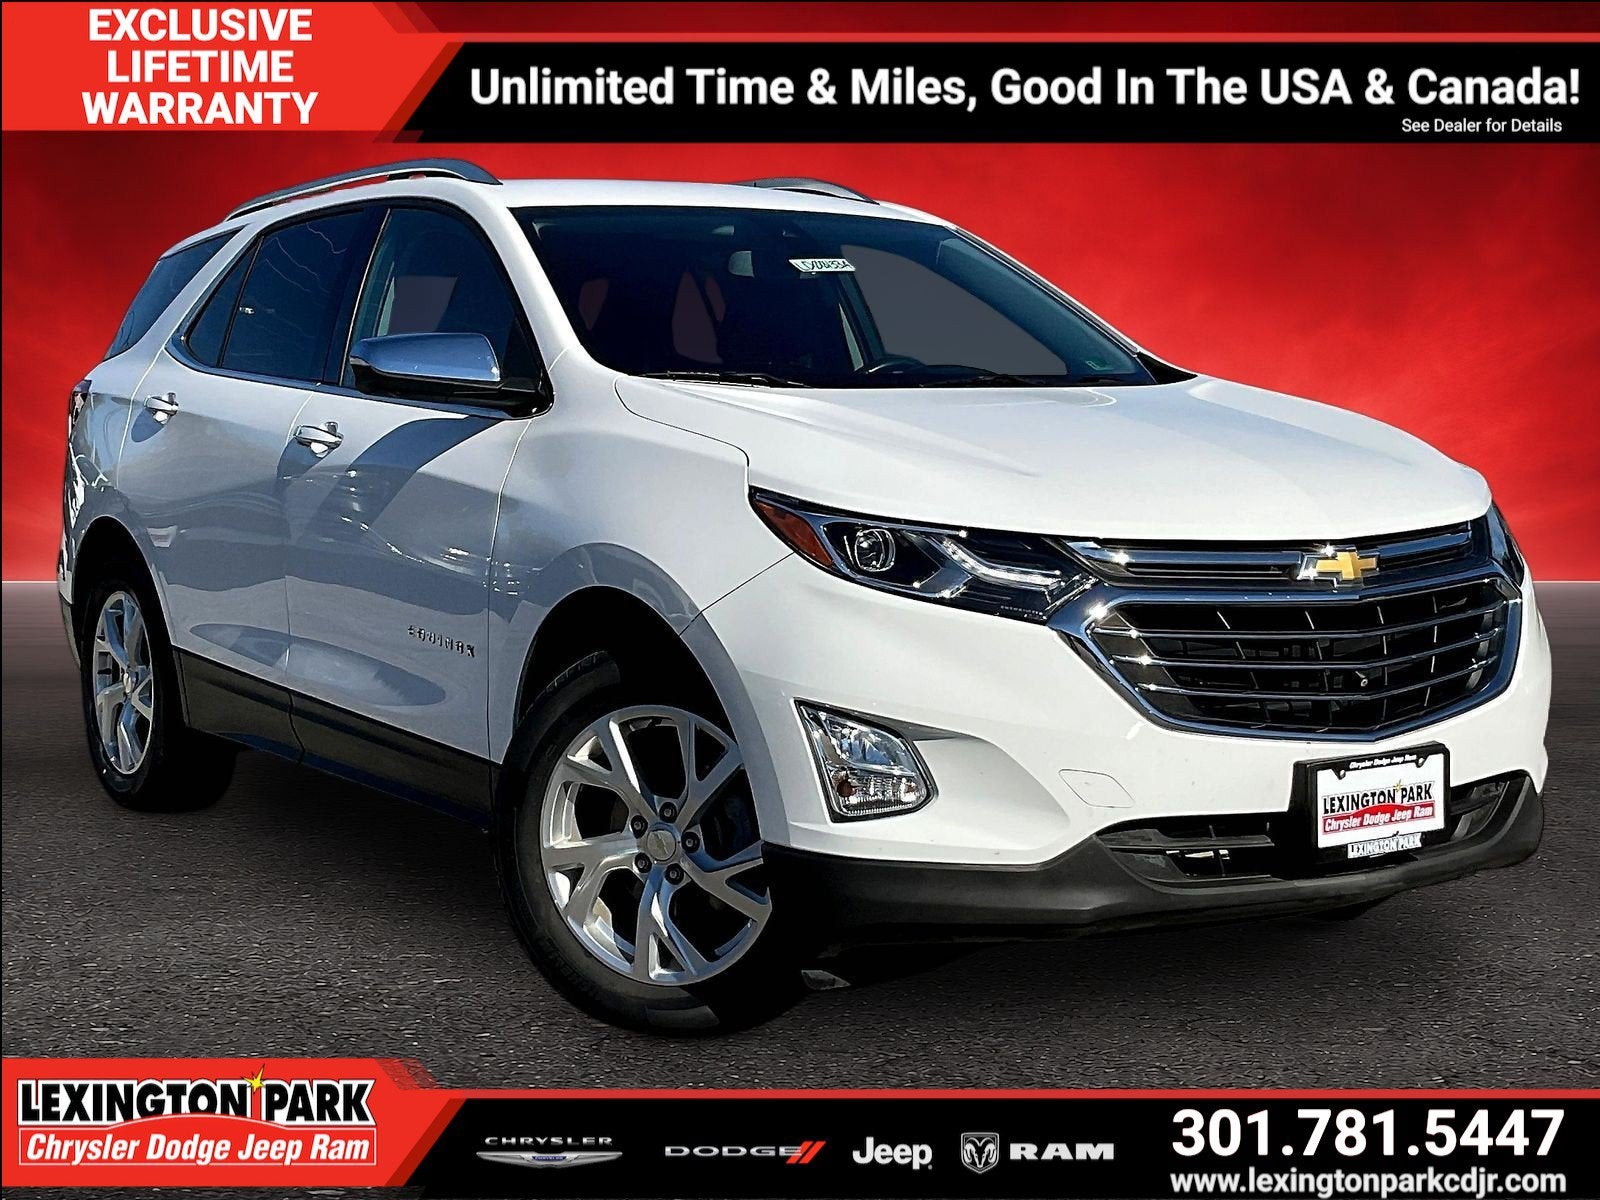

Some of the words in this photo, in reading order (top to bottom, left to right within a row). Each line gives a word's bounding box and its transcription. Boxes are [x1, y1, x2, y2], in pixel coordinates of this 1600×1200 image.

[1322, 787, 1396, 815] LEXINGTON
[1400, 783, 1433, 804] PARK
[1324, 816, 1362, 832] Chrysler
[1362, 813, 1390, 826] Dodge
[1391, 808, 1412, 822] Jeep
[1413, 805, 1433, 818] Ram
[1347, 836, 1398, 858] LEXINGTON
[1398, 832, 1422, 851] PARK
